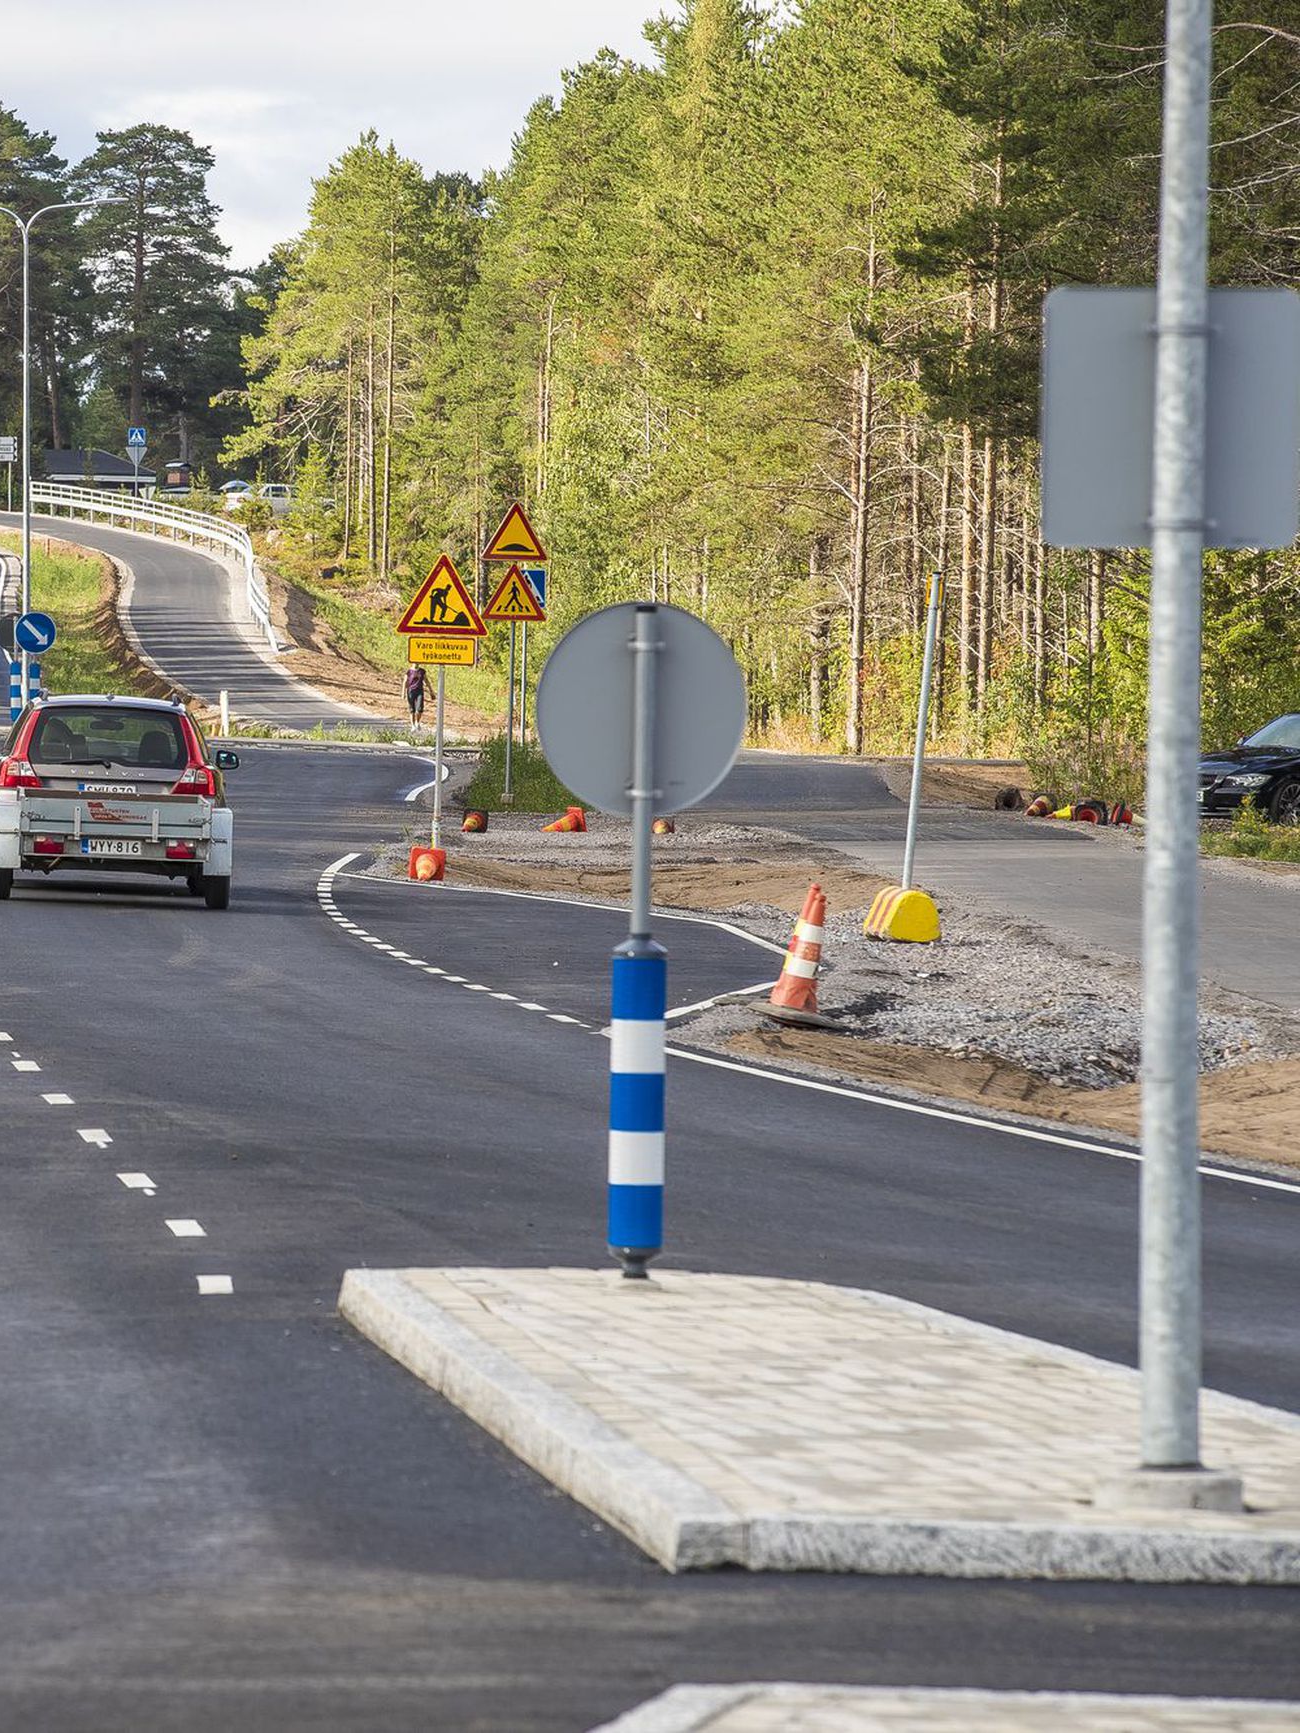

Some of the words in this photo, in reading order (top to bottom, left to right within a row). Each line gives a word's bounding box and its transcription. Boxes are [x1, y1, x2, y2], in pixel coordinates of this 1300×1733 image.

[416, 641, 433, 649] Varo
[422, 651, 461, 660] työkonetta
[91, 840, 139, 853] WYY-816
